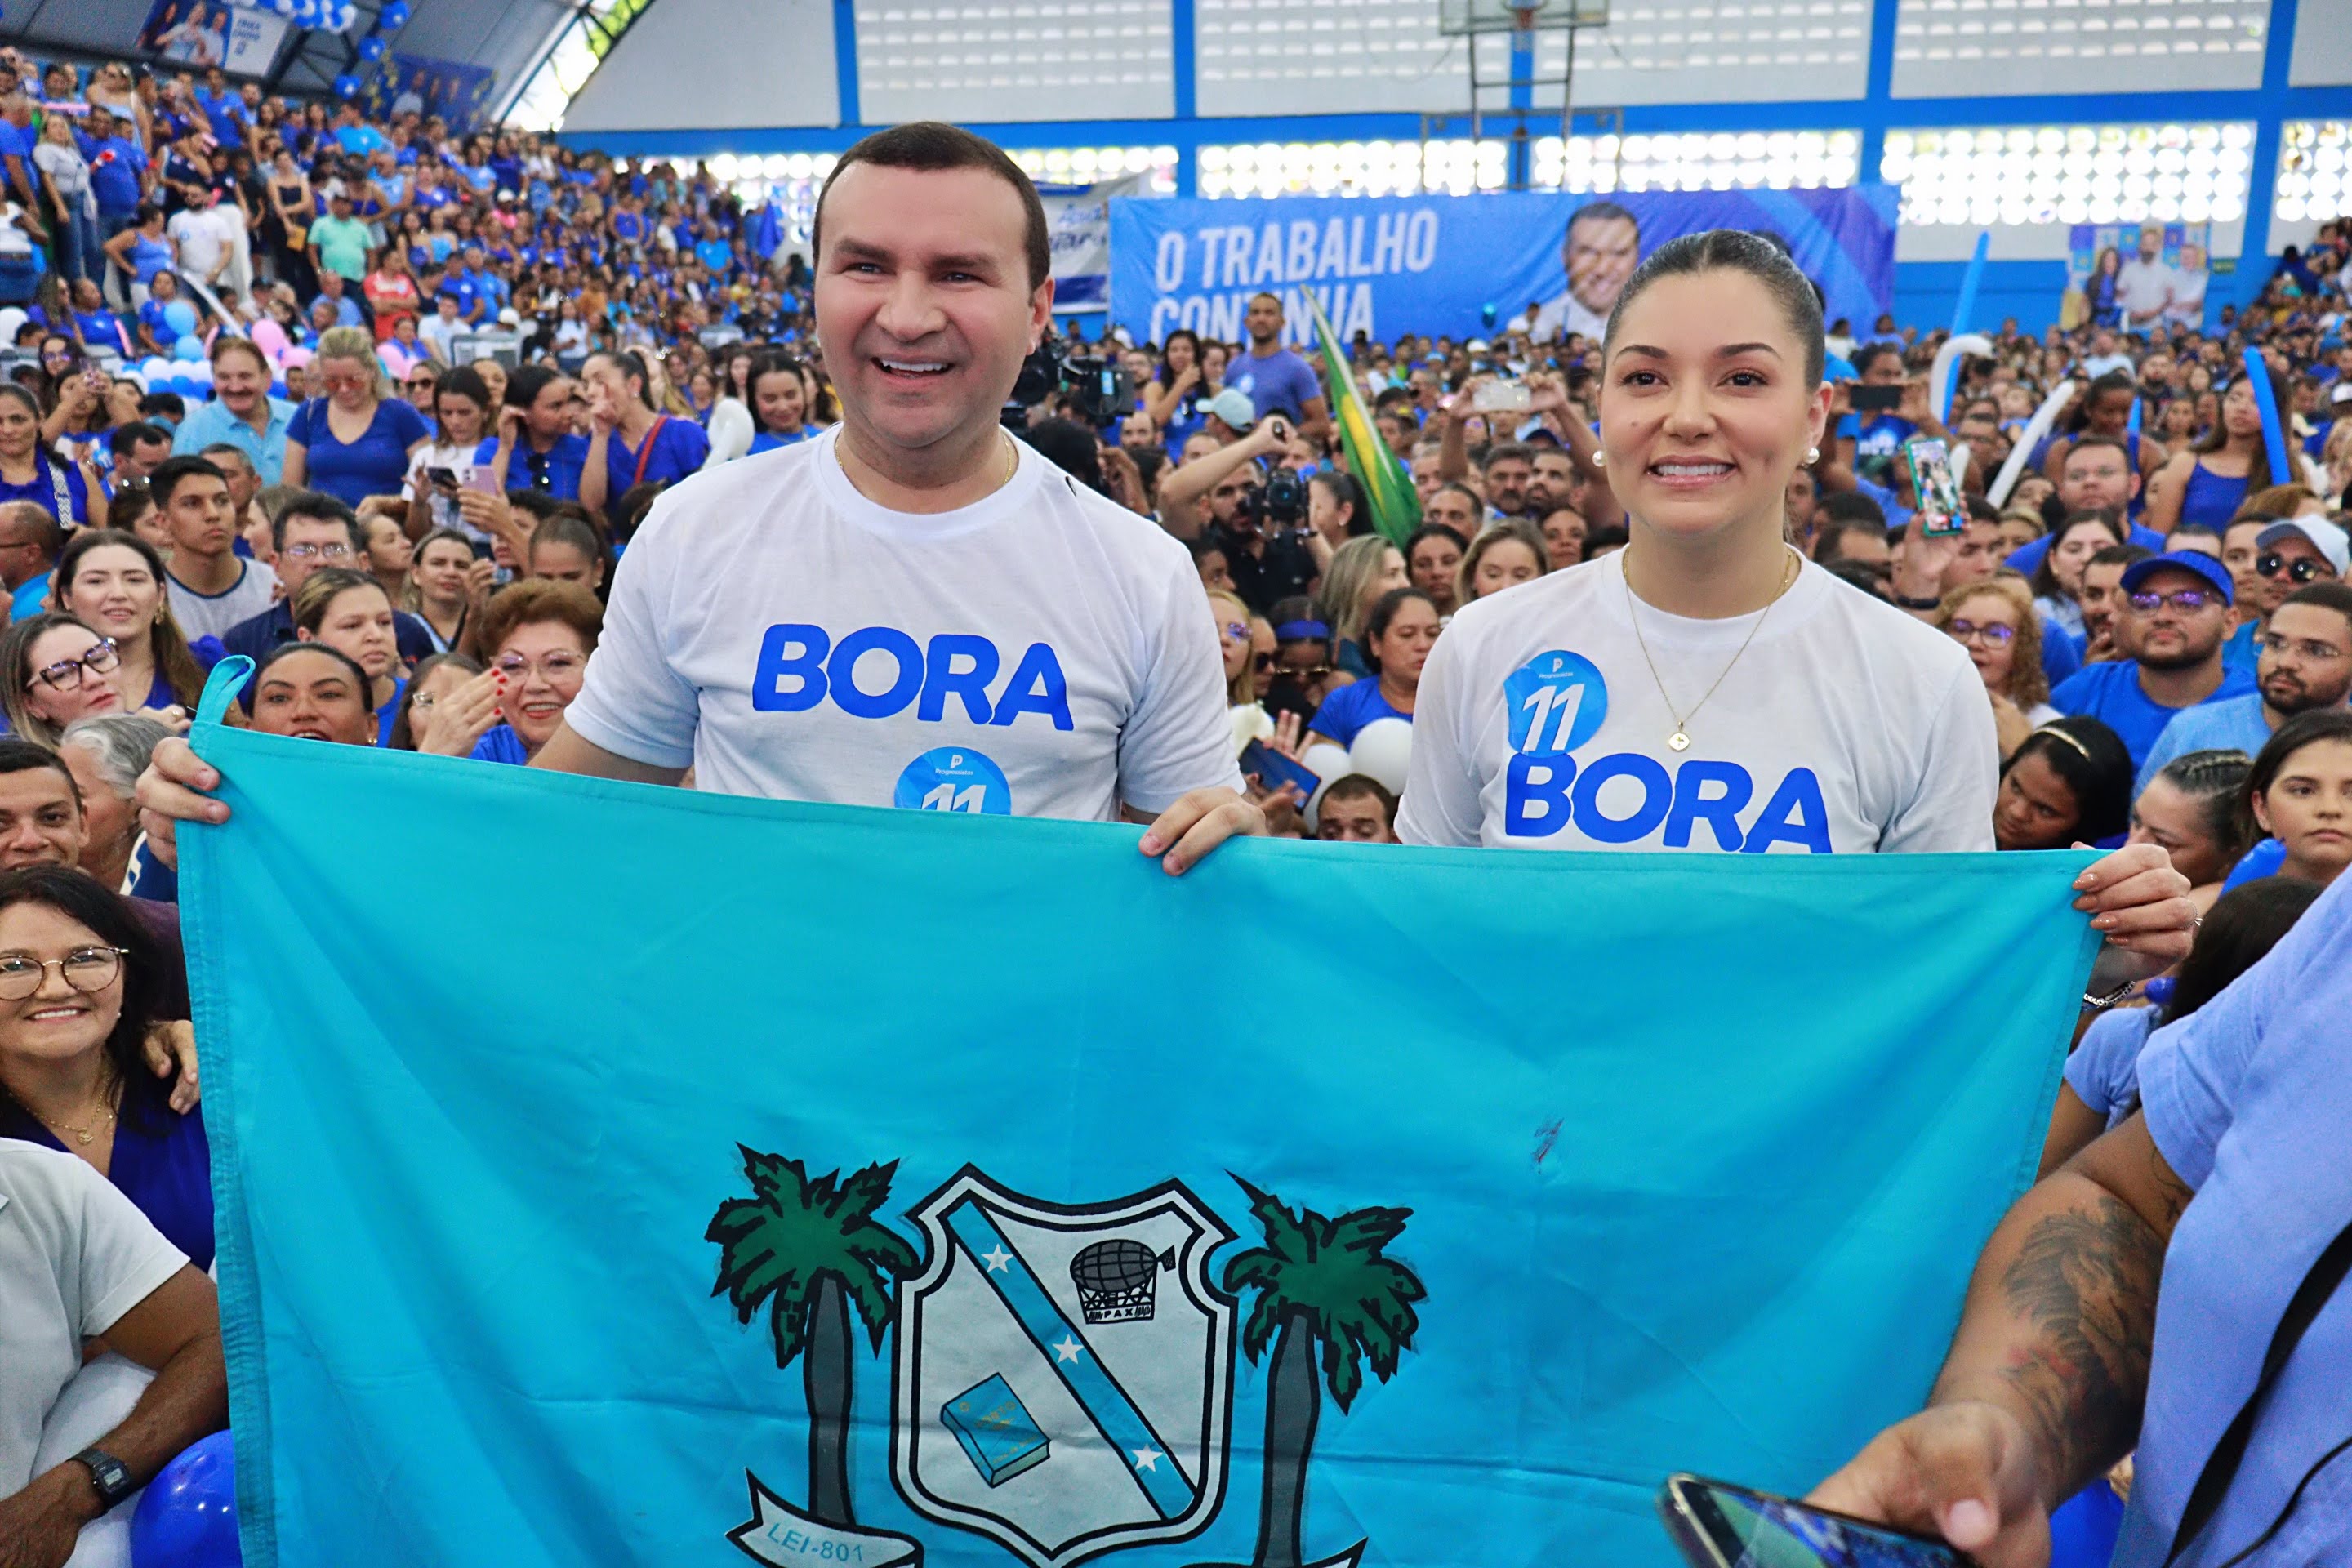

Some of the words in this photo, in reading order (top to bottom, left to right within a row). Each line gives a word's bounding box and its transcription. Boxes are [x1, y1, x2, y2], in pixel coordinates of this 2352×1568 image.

[1156, 231, 1187, 293] O
[1198, 208, 1438, 288] TRABALHO
[753, 624, 1075, 732] BORA
[1522, 683, 1585, 751] 11
[921, 783, 987, 813] 11
[935, 768, 974, 776] Progressistas
[1505, 752, 1833, 854] BORA
[1103, 1307, 1134, 1318] PAX
[766, 1522, 862, 1562] LEI-801
